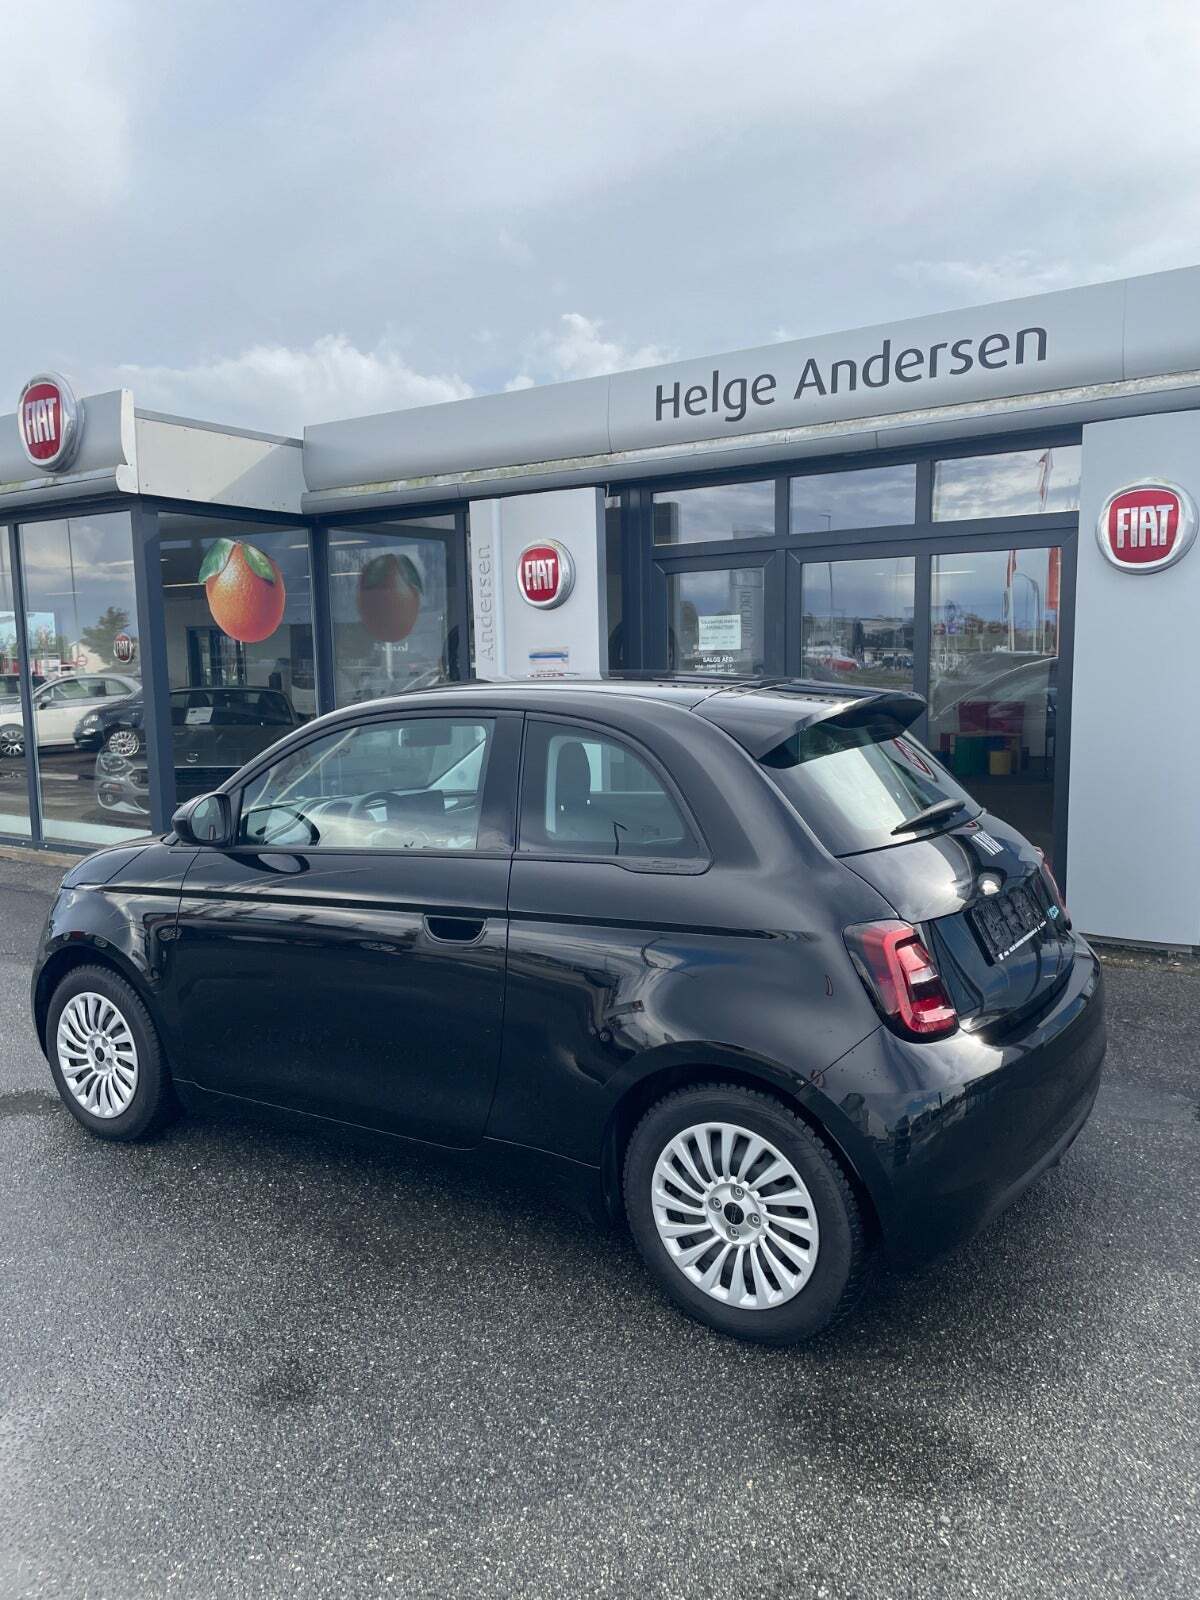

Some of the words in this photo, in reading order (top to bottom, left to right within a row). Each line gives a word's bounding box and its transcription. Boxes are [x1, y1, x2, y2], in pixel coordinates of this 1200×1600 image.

[655, 370, 777, 422] Helge
[793, 326, 1048, 400] Andersen
[25, 397, 57, 445] FIAT
[1117, 504, 1174, 549] FIAT
[525, 558, 556, 591] FIAT
[476, 545, 494, 664] Andersen
